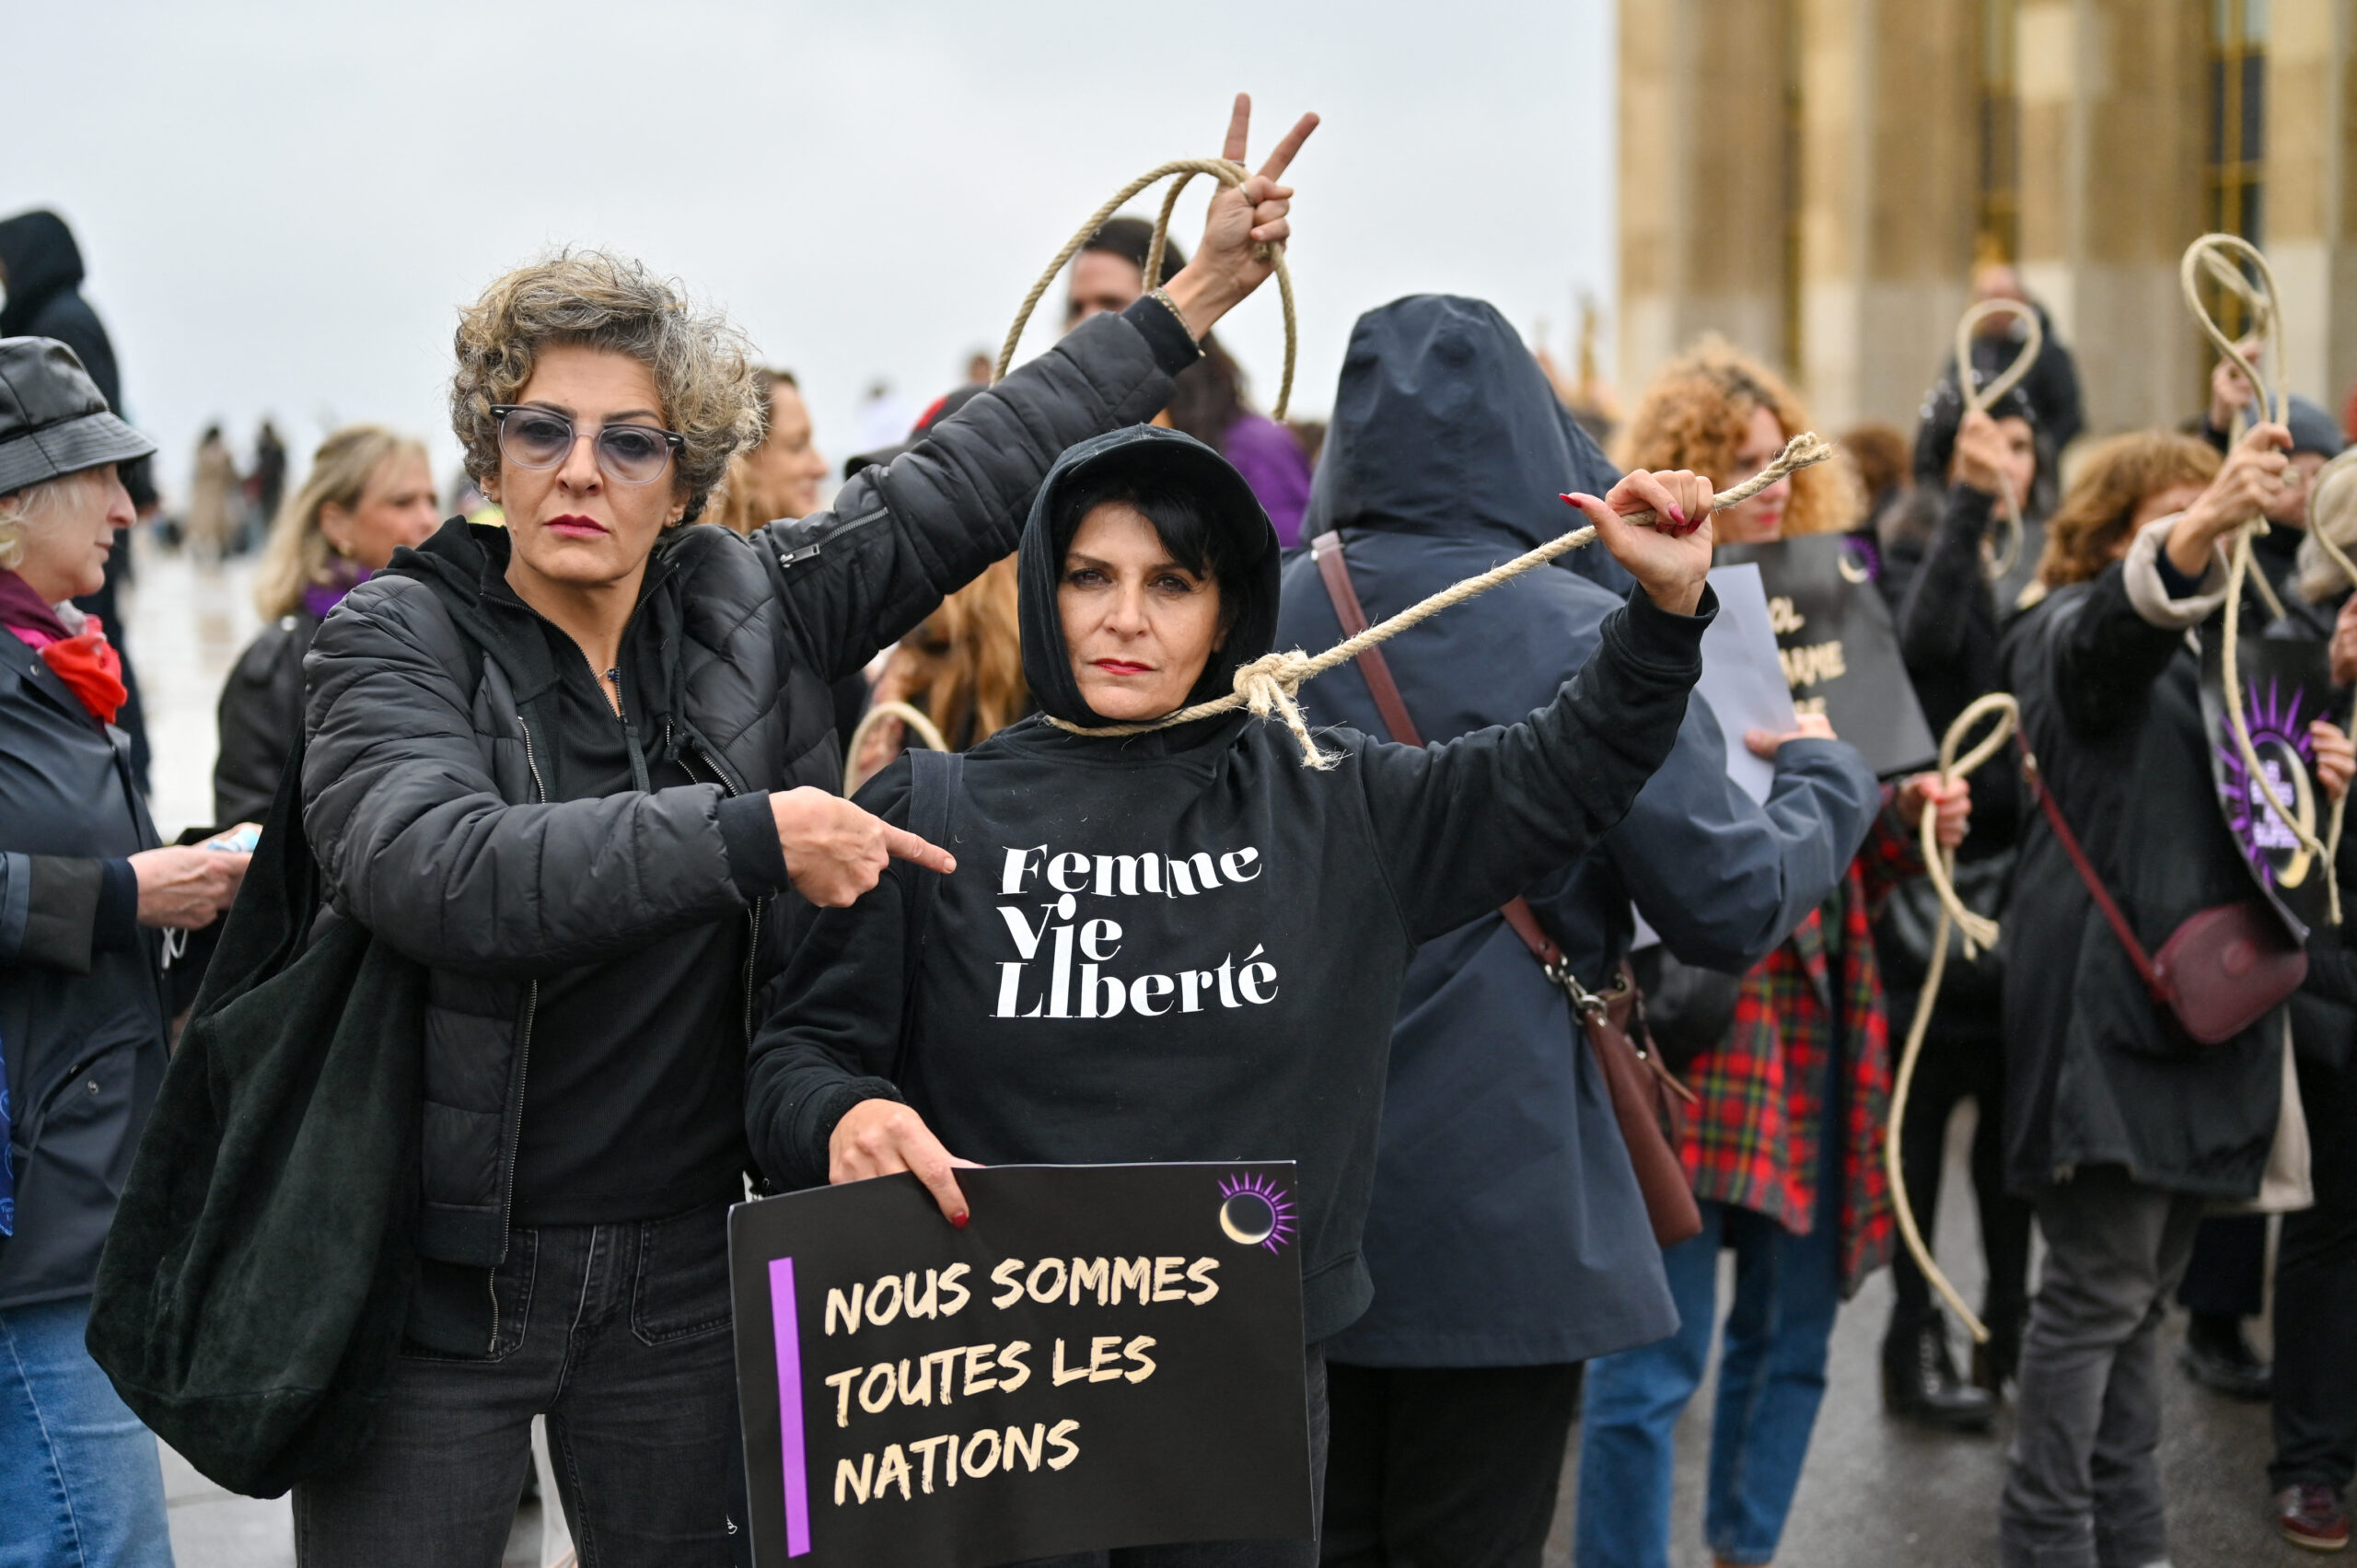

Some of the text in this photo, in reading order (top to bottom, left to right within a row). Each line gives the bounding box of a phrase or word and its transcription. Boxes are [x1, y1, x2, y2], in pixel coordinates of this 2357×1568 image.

[1768, 596, 1805, 634] OL
[997, 843, 1262, 899] Femme
[995, 892, 1123, 961] Vie
[989, 943, 1279, 1018] Liberté
[824, 1256, 1220, 1336] NOUS SOMMES
[825, 1334, 1157, 1428] TOUTES LES
[834, 1419, 1081, 1506] NATIONS
